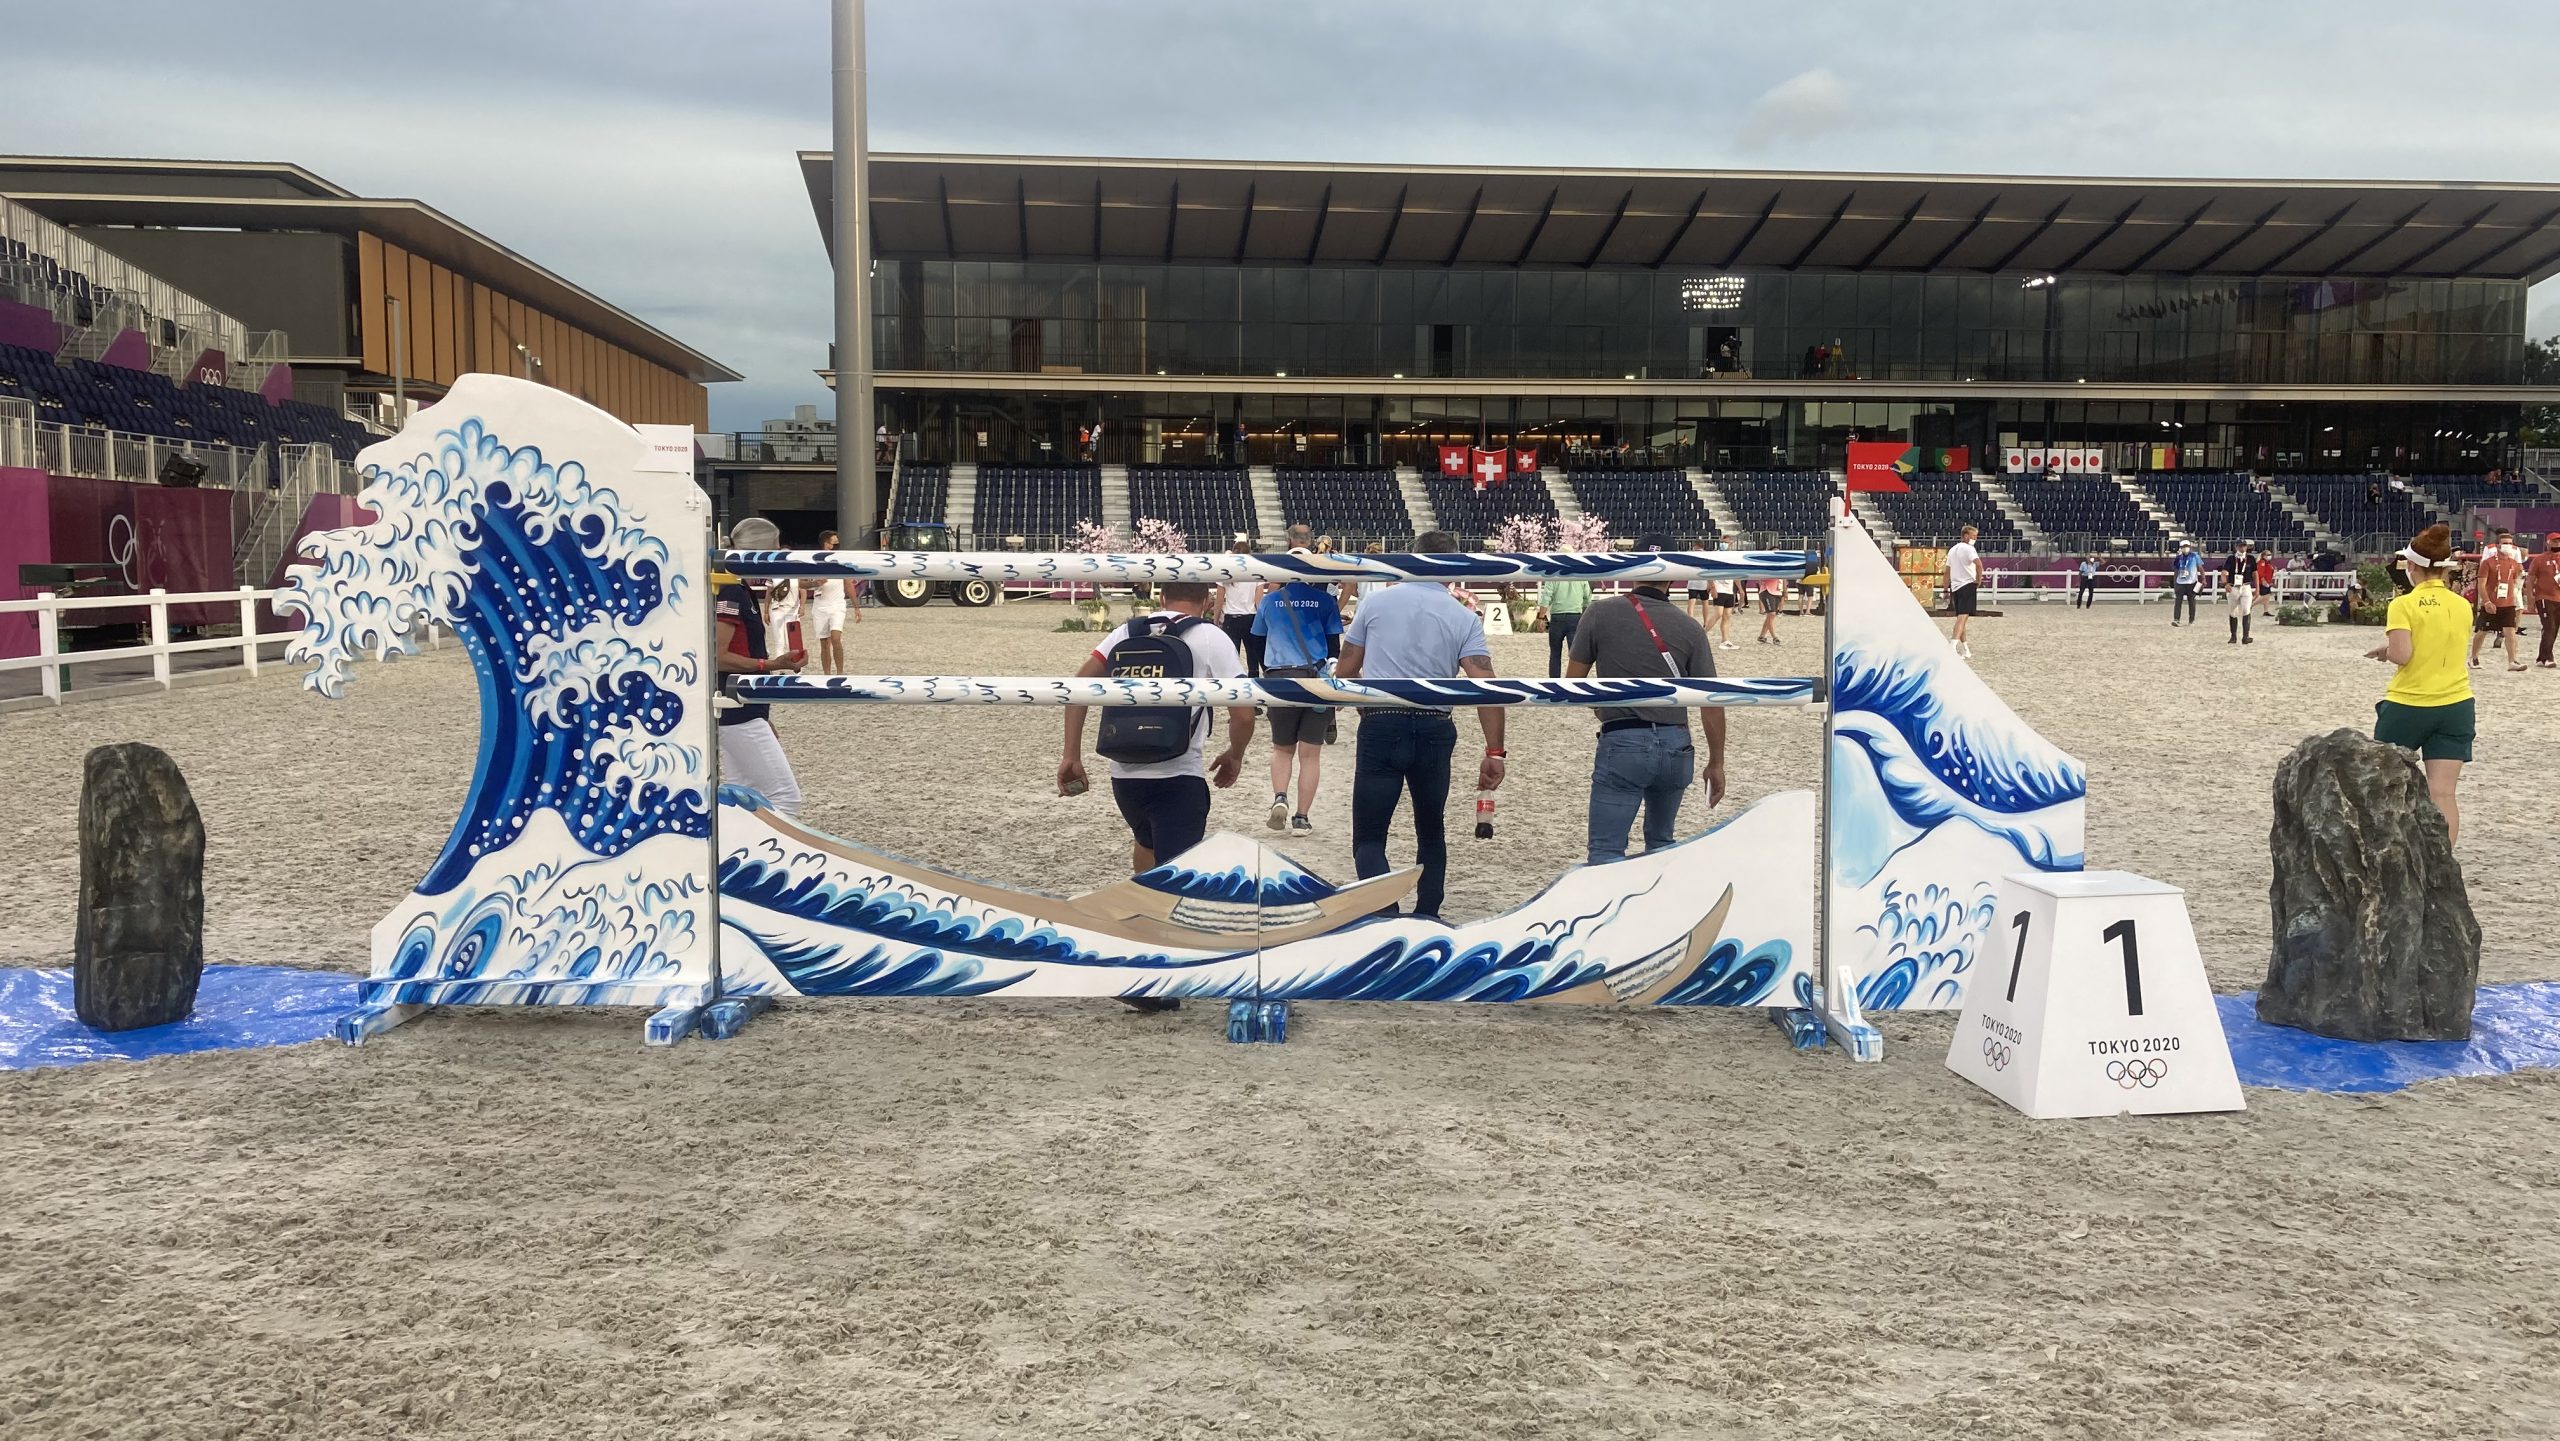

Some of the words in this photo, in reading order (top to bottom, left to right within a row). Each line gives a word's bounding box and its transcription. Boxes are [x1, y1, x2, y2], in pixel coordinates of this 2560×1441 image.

[1853, 463, 1873, 471] TOKYO
[1275, 600, 1299, 608] TOYO
[1300, 600, 1319, 608] 2020
[1492, 607, 1502, 622] 2
[1111, 665, 1164, 679] CZECH
[2006, 910, 2031, 1003] 1
[2103, 919, 2144, 1016] 1
[1982, 1014, 2004, 1036] TOKYO
[2004, 1026, 2022, 1045] 2020
[2088, 1039, 2139, 1055] TOKYO
[2143, 1037, 2180, 1052] 2020
